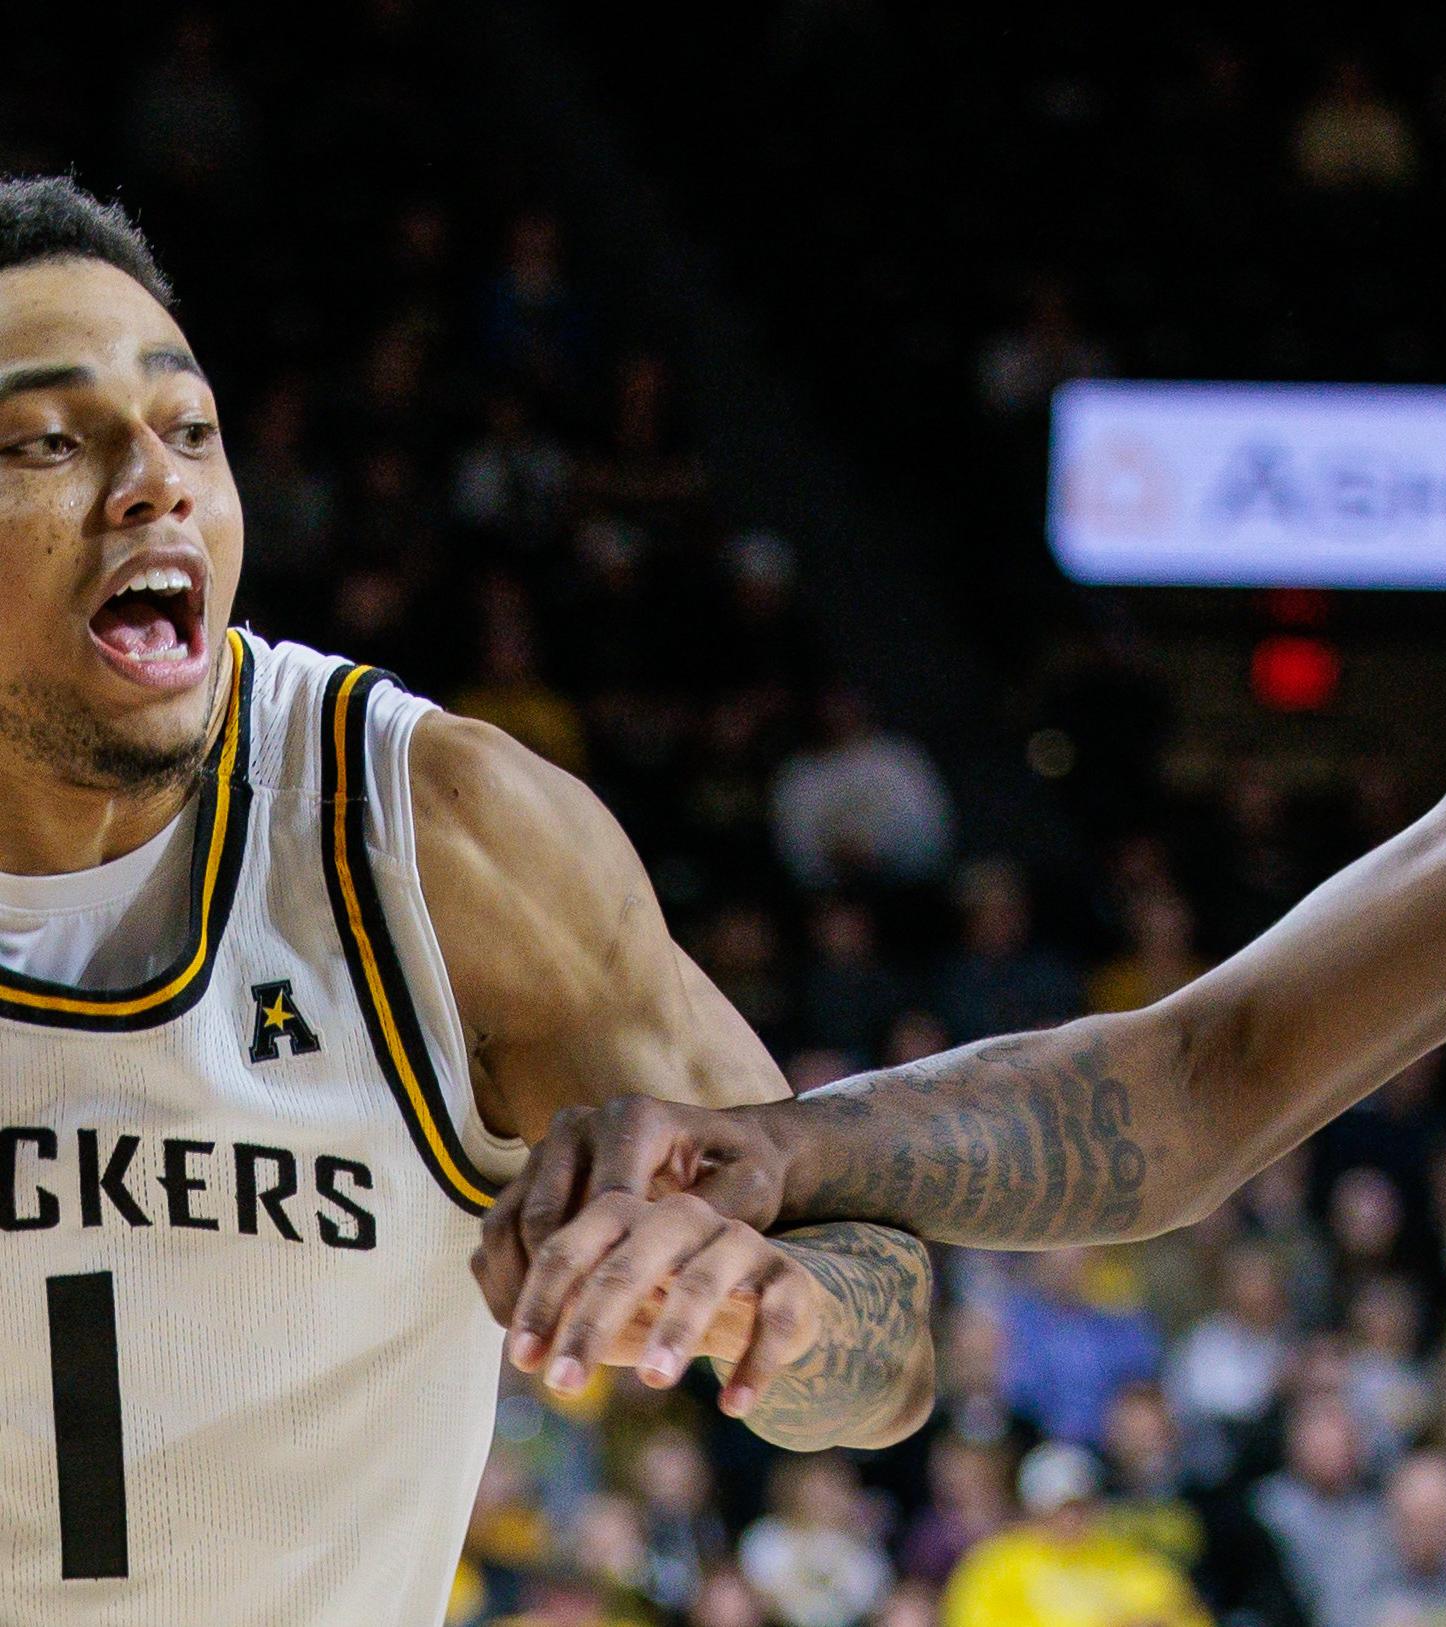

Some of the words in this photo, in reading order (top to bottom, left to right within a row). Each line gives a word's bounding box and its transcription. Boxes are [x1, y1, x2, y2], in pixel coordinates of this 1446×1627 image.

[248, 979, 322, 1064] A
[0, 1126, 377, 1250] CKERS
[46, 1270, 130, 1580] 1
